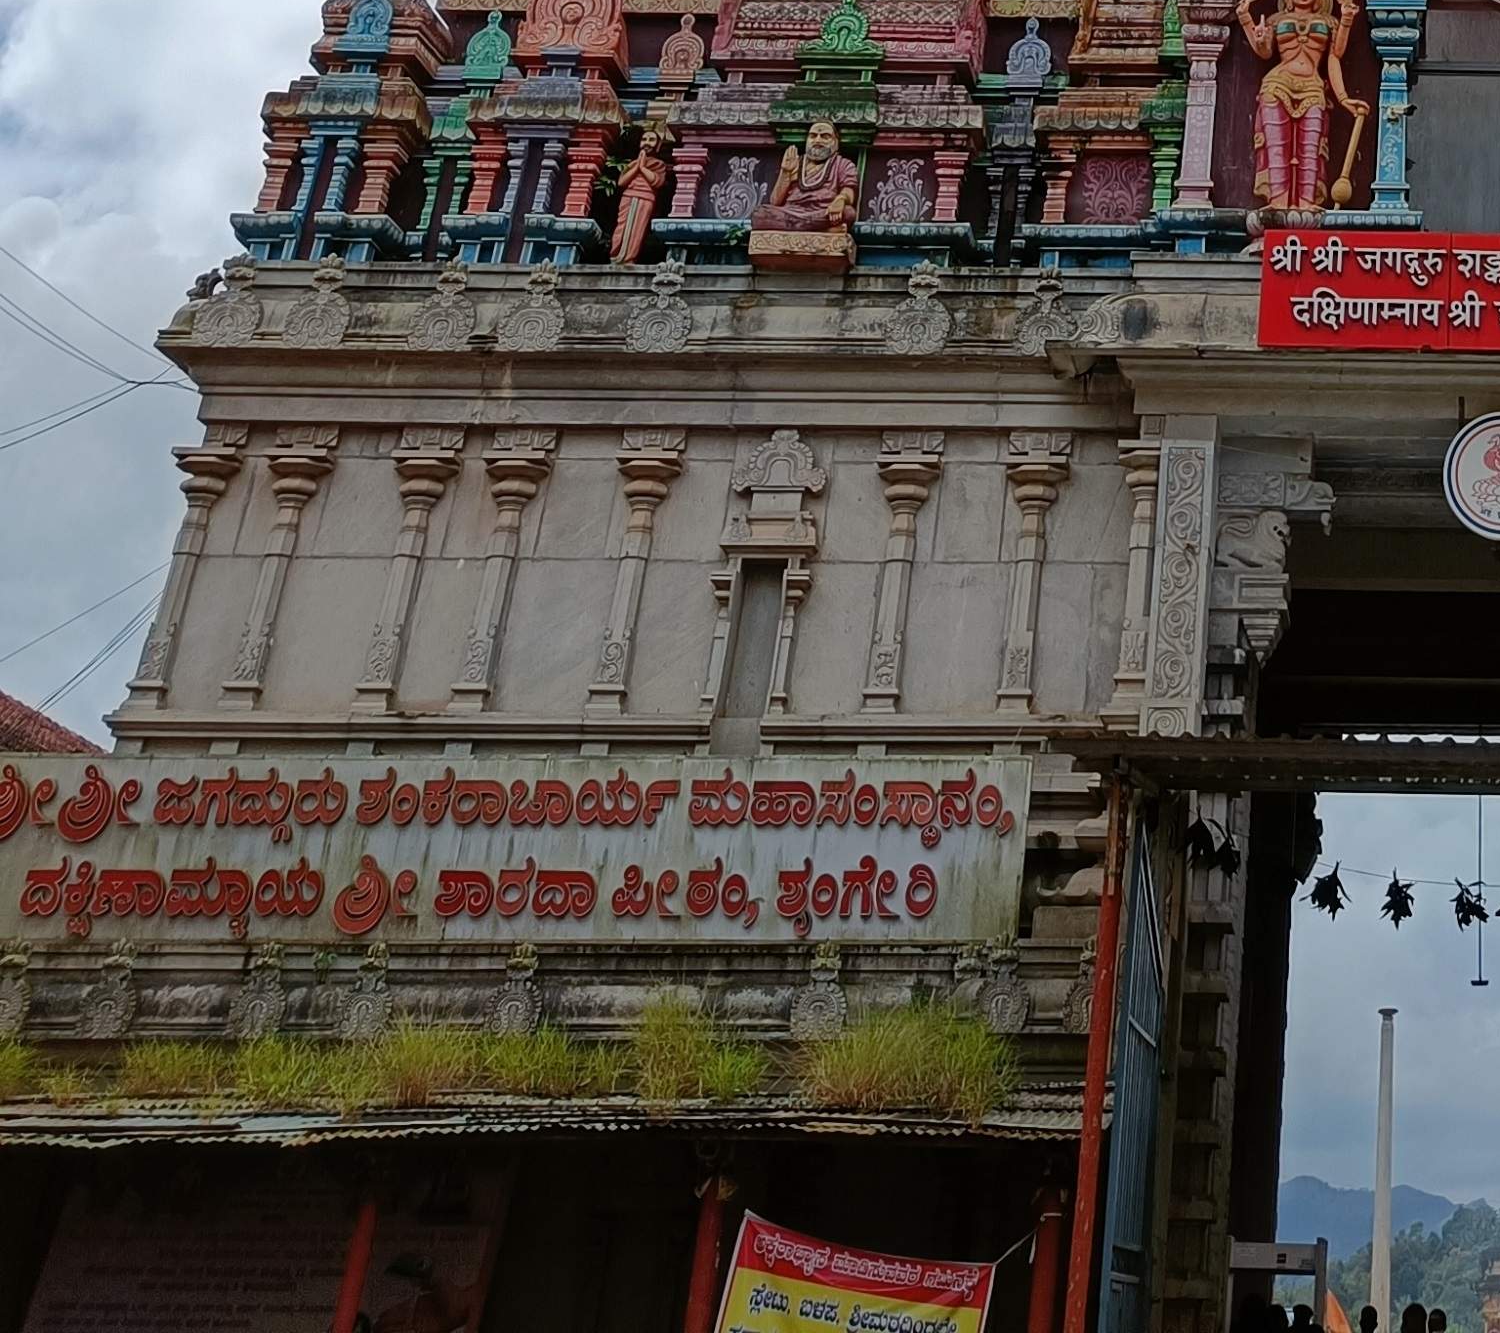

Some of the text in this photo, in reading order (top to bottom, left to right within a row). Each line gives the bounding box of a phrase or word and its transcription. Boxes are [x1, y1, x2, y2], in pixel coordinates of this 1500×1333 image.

[1269, 235, 1308, 272] श्री
[1311, 236, 1350, 273] श्री
[1354, 247, 1447, 286] जगद्गुरु
[1290, 287, 1444, 330] दक्षिणाम्नाय
[1448, 290, 1486, 328] श्री
[57, 764, 142, 844] ಶ್ರೀ
[153, 766, 348, 844] ಜಗದ್ಗುರು
[356, 766, 680, 827] ಶಂಕರಾಚಾರ್ಯ
[19, 856, 324, 939] ದಕ್ಷಿಣಾಮ್ನಾಯ
[332, 854, 418, 934] ಶ್ರೀ
[433, 857, 597, 918] ಶಾರದಾ
[775, 855, 938, 937] ಶೃಂಗೇರಿ
